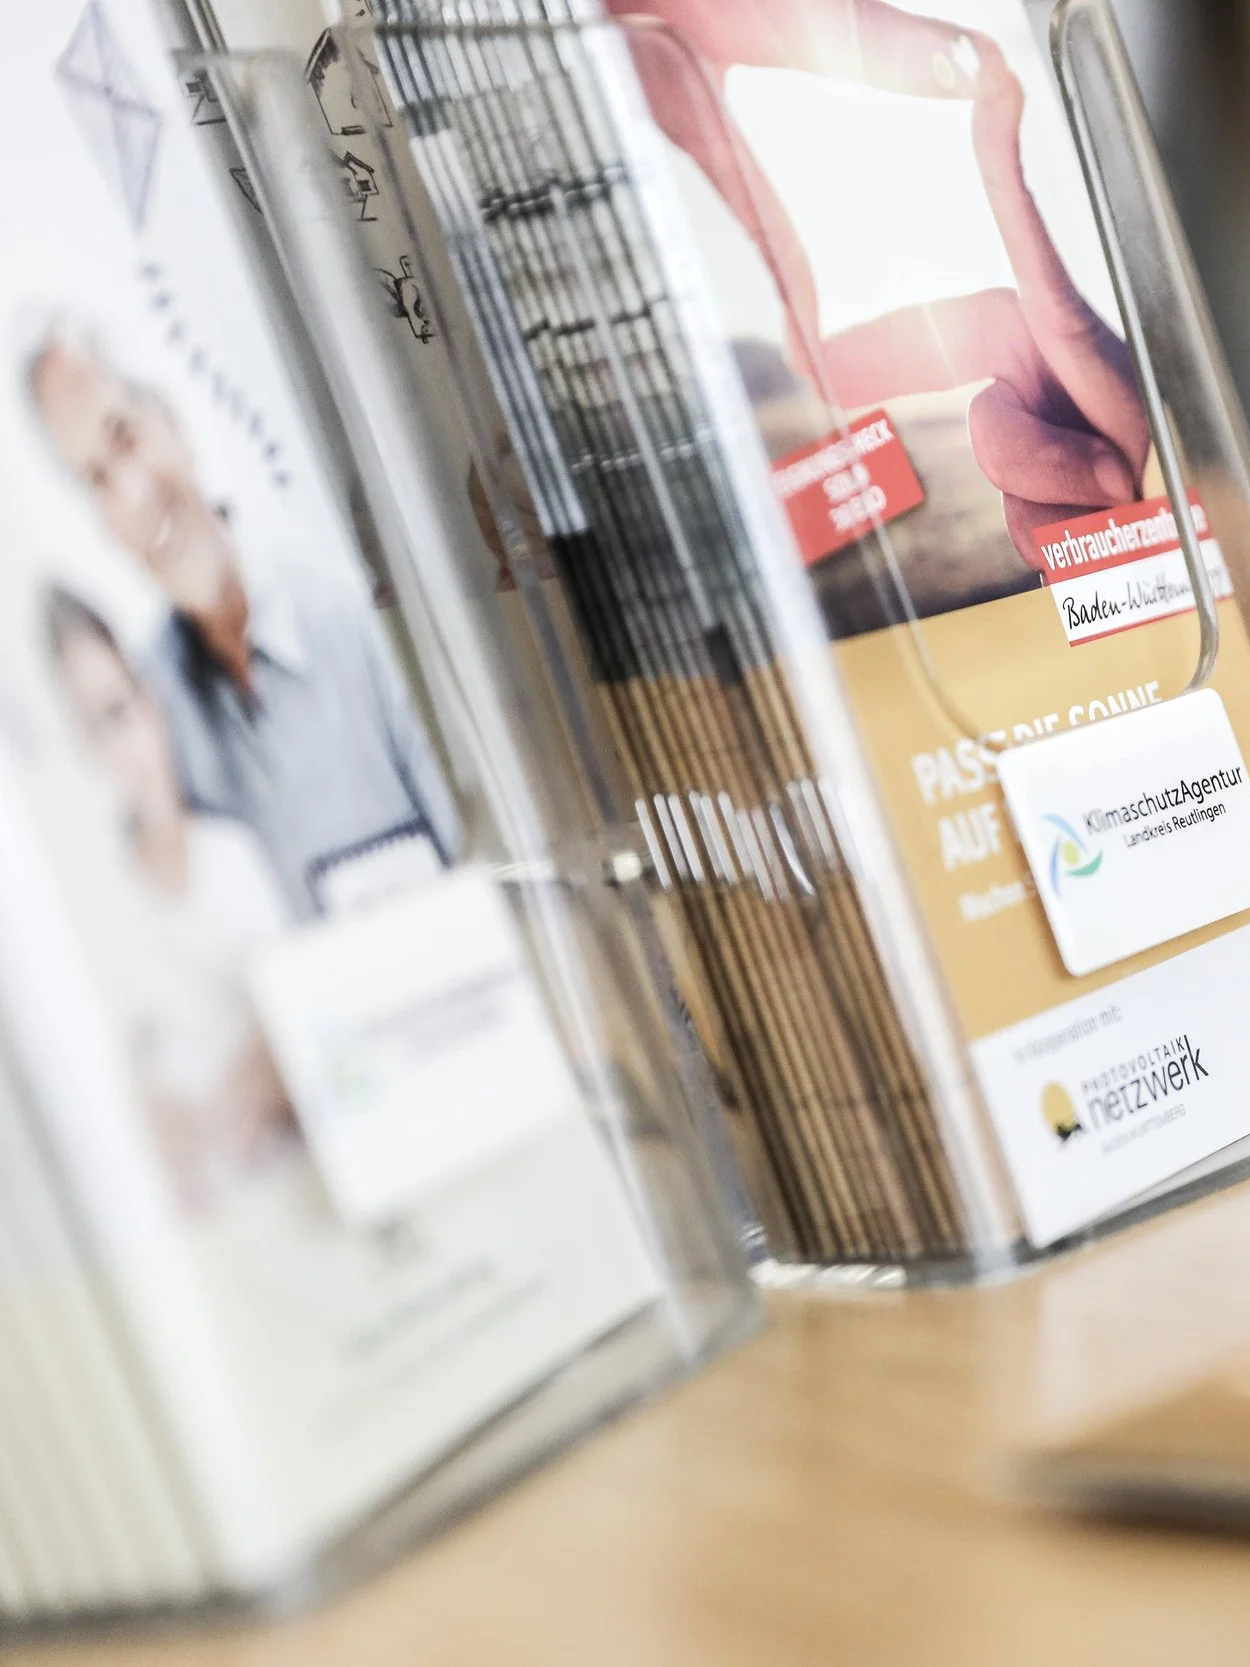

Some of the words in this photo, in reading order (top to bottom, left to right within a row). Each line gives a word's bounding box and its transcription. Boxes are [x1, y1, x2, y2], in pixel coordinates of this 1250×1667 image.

[1083, 766, 1243, 836] KlimaschutzAgentur
[1123, 820, 1173, 848] Landkreis
[1172, 802, 1226, 831] Reutlingen
[1087, 1034, 1209, 1130] netzwerk
